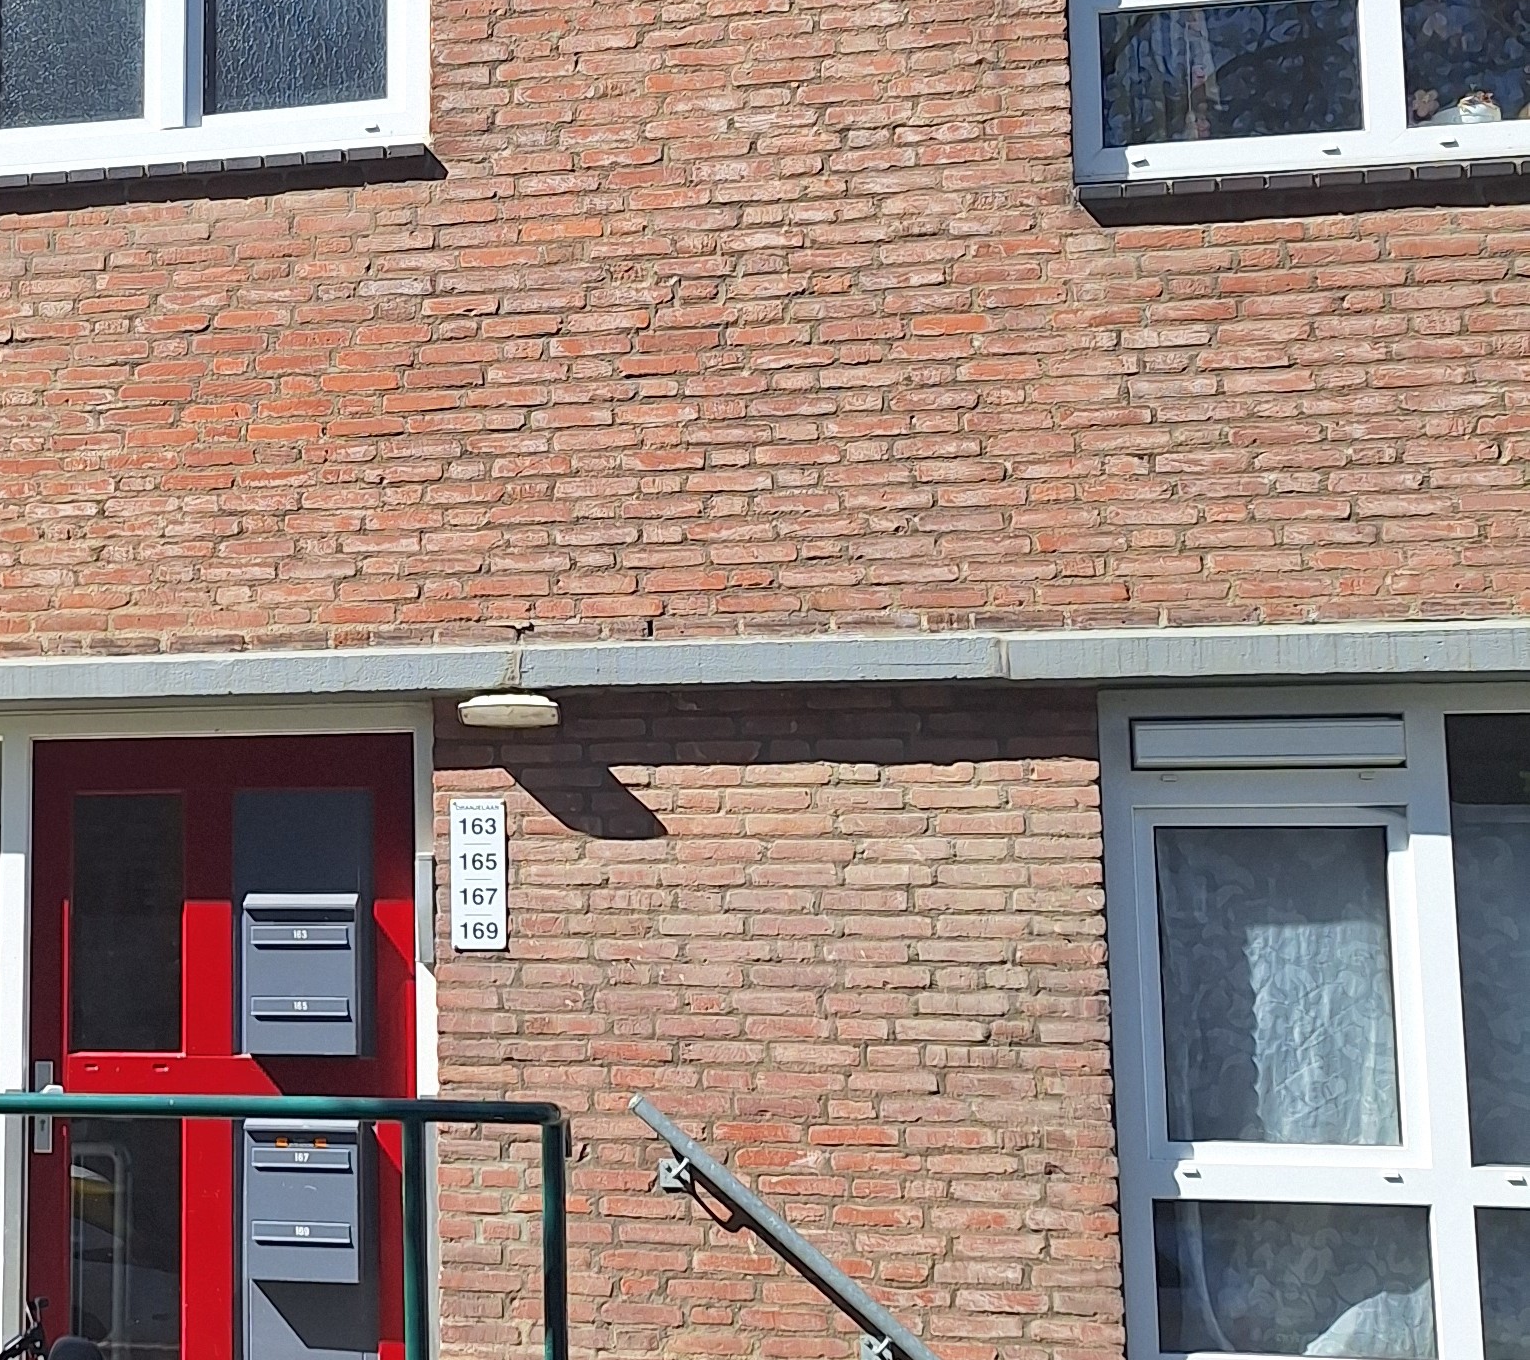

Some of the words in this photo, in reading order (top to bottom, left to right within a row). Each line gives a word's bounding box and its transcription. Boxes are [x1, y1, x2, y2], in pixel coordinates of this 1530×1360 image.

[459, 817, 497, 835] 163
[459, 853, 498, 870] 165
[459, 888, 498, 905] 167
[293, 929, 308, 940] 163
[460, 922, 499, 940] 169
[293, 1001, 308, 1011] 165
[294, 1152, 310, 1163] 167
